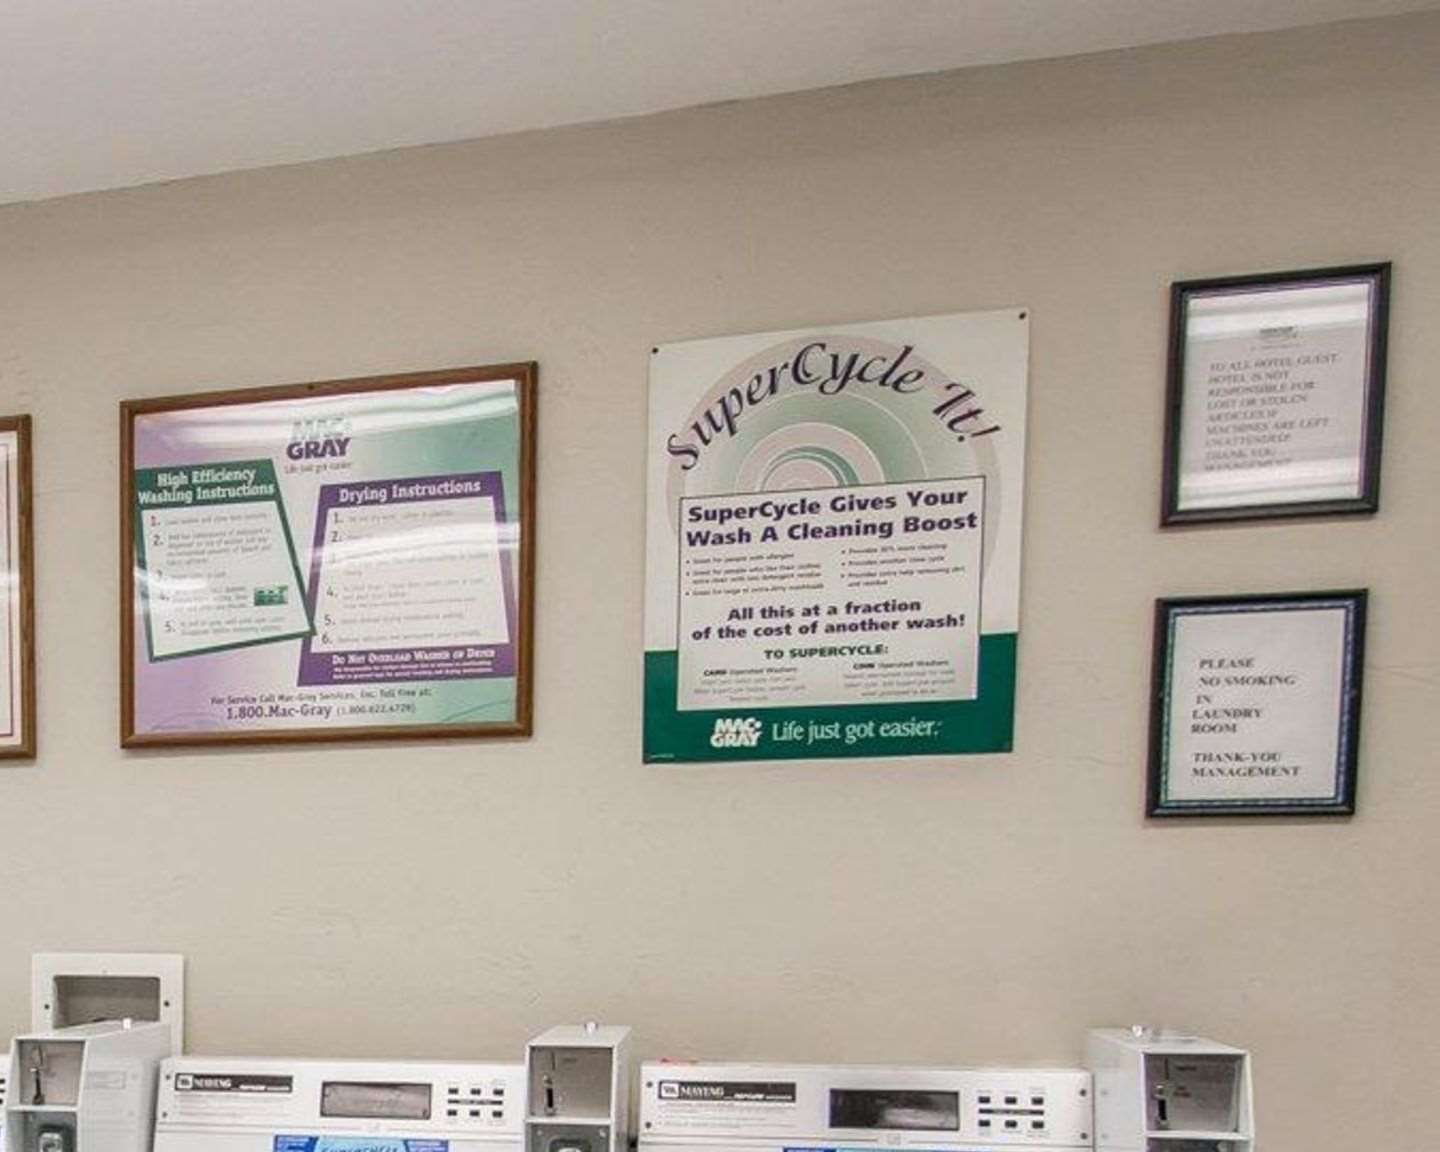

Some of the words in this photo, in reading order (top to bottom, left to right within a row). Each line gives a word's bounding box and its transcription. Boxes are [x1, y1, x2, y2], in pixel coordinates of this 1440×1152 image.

[667, 342, 924, 471] SuperCycle
[286, 437, 352, 461] GRAY
[157, 471, 189, 488] High
[192, 467, 257, 485] Efficiency
[138, 487, 193, 506] Washing
[196, 481, 275, 500] Instructions
[339, 486, 388, 505] Drying
[392, 480, 482, 499] Instructions
[688, 500, 821, 525] SuperCycle
[830, 494, 897, 513] Gives
[906, 489, 969, 507] Your
[686, 526, 752, 547] Wash
[761, 525, 779, 543] A
[787, 519, 895, 542] Cleaning
[903, 512, 978, 533] Boost
[727, 604, 755, 621] All
[760, 603, 795, 620] this
[801, 604, 821, 618] at
[826, 605, 839, 617] a
[845, 599, 922, 616] fraction
[691, 625, 710, 641] of
[717, 624, 747, 640] the
[753, 622, 792, 638] cost
[798, 620, 819, 635] of
[824, 617, 900, 634] another
[905, 613, 966, 631] wash!
[763, 649, 785, 661] TO
[788, 644, 889, 660] SUPERCYCLE:
[1199, 657, 1255, 669] PLEASE
[1199, 675, 1221, 688] NO
[1224, 674, 1297, 687] SMOKING
[1196, 694, 1212, 705] IN
[226, 703, 333, 721] 1.800.Mac-Gray
[1192, 707, 1262, 720] LAUNDRY
[710, 730, 763, 749] GRAY
[772, 719, 805, 742] Life
[806, 720, 841, 745] just
[845, 721, 875, 745] got
[1190, 722, 1238, 734] ROOM
[1193, 751, 1282, 764] THANK-YOU
[1191, 765, 1301, 778] MANAGEMENT
